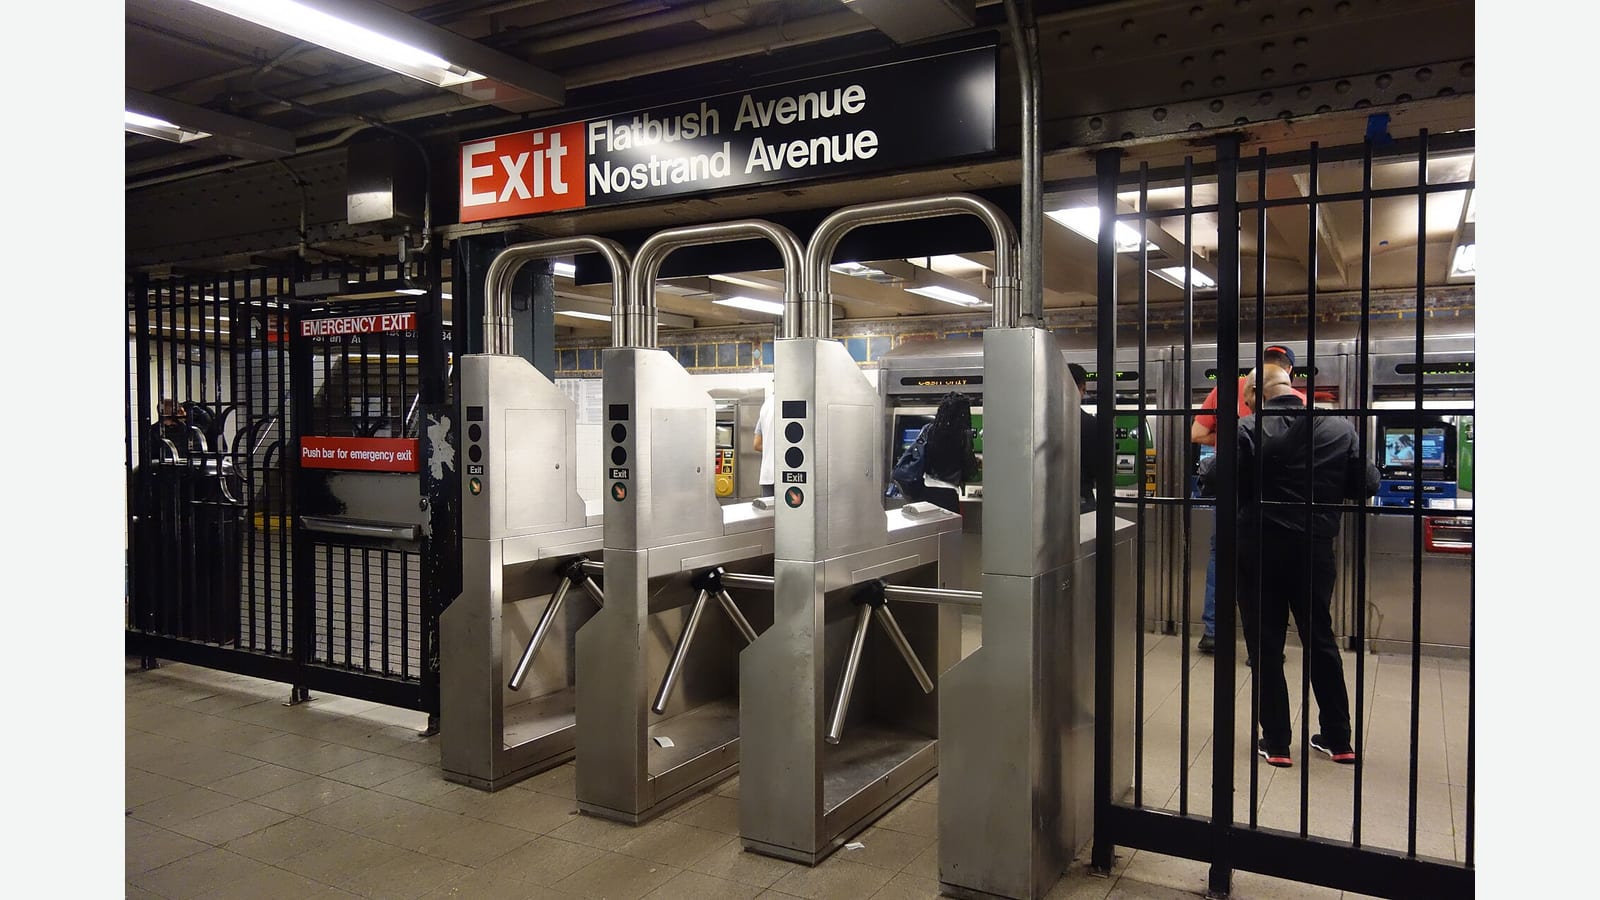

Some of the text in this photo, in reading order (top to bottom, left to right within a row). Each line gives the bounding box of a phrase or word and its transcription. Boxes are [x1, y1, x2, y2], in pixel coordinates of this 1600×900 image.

[588, 84, 867, 155] Flatbush Avenue
[462, 132, 569, 207] Exit
[589, 129, 879, 195] Nostrand Avenue
[303, 315, 376, 336] EMERGENCY
[382, 314, 411, 331] EXIT
[302, 447, 412, 462] Push bar for emergency exit
[469, 465, 482, 474] Exit
[612, 469, 627, 479] Exit
[786, 472, 804, 482] Exit
